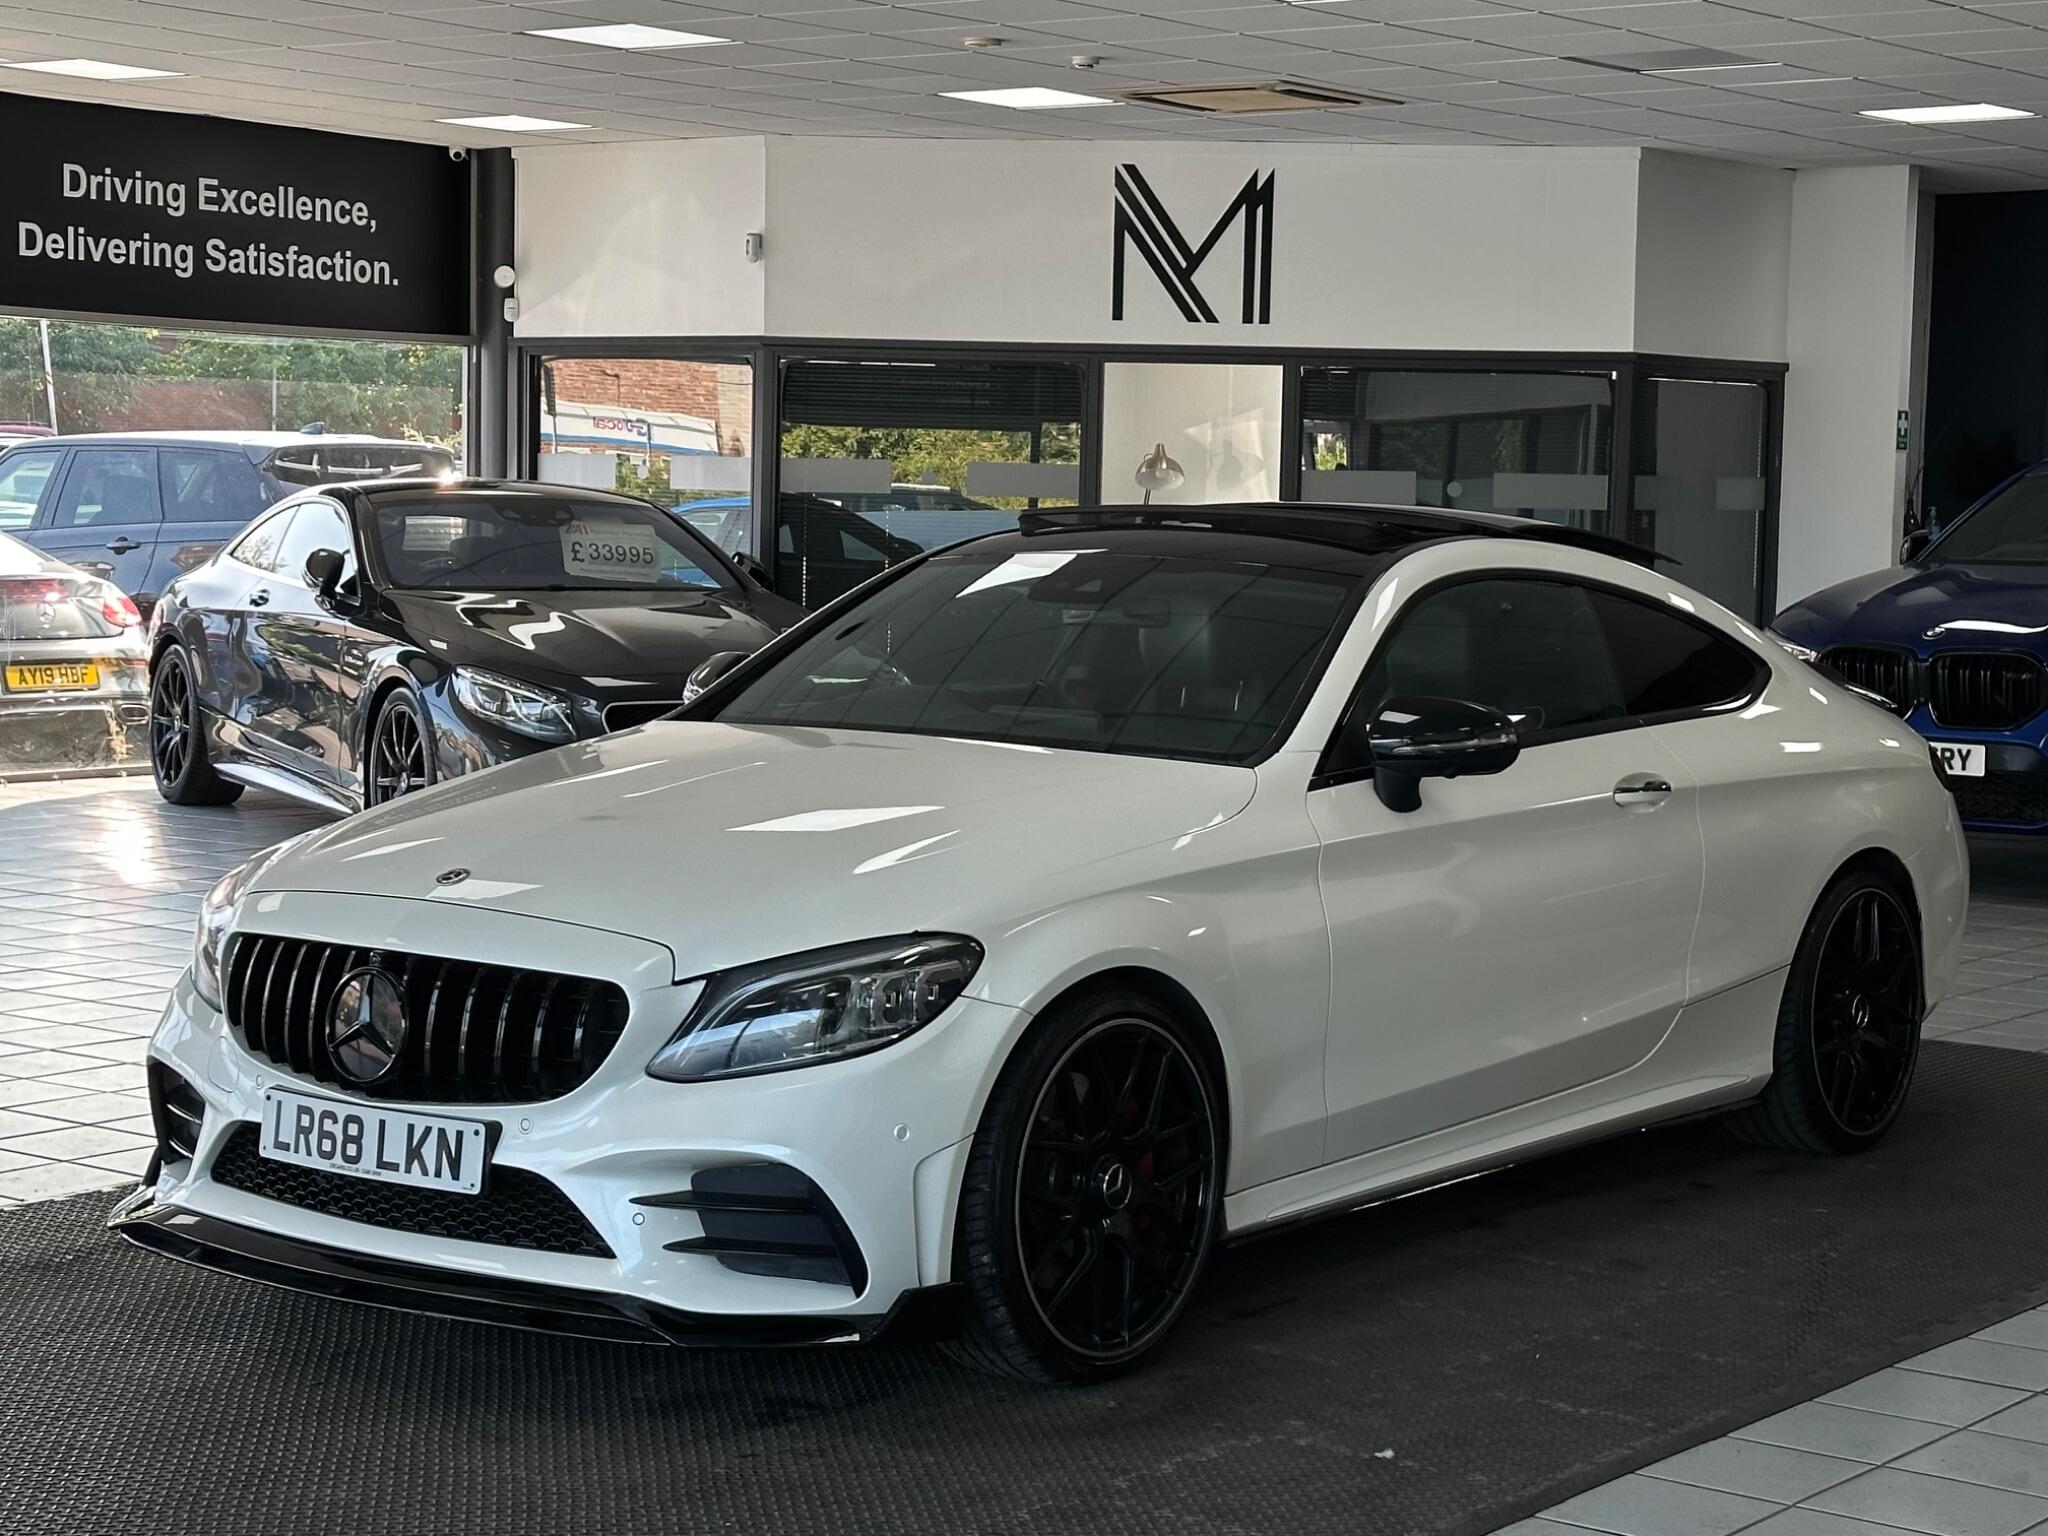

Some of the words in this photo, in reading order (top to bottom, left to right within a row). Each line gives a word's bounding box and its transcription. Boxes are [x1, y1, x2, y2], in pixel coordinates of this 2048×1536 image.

[63, 163, 186, 217] Driving
[198, 177, 377, 233] Excellence,
[18, 221, 193, 278] Delivering
[205, 238, 399, 286] Satisfaction.
[570, 541, 655, 565] £33995
[59, 666, 89, 685] HBF
[1930, 746, 1972, 771] RY
[272, 1100, 365, 1165] LR68
[375, 1118, 465, 1182] LKN
